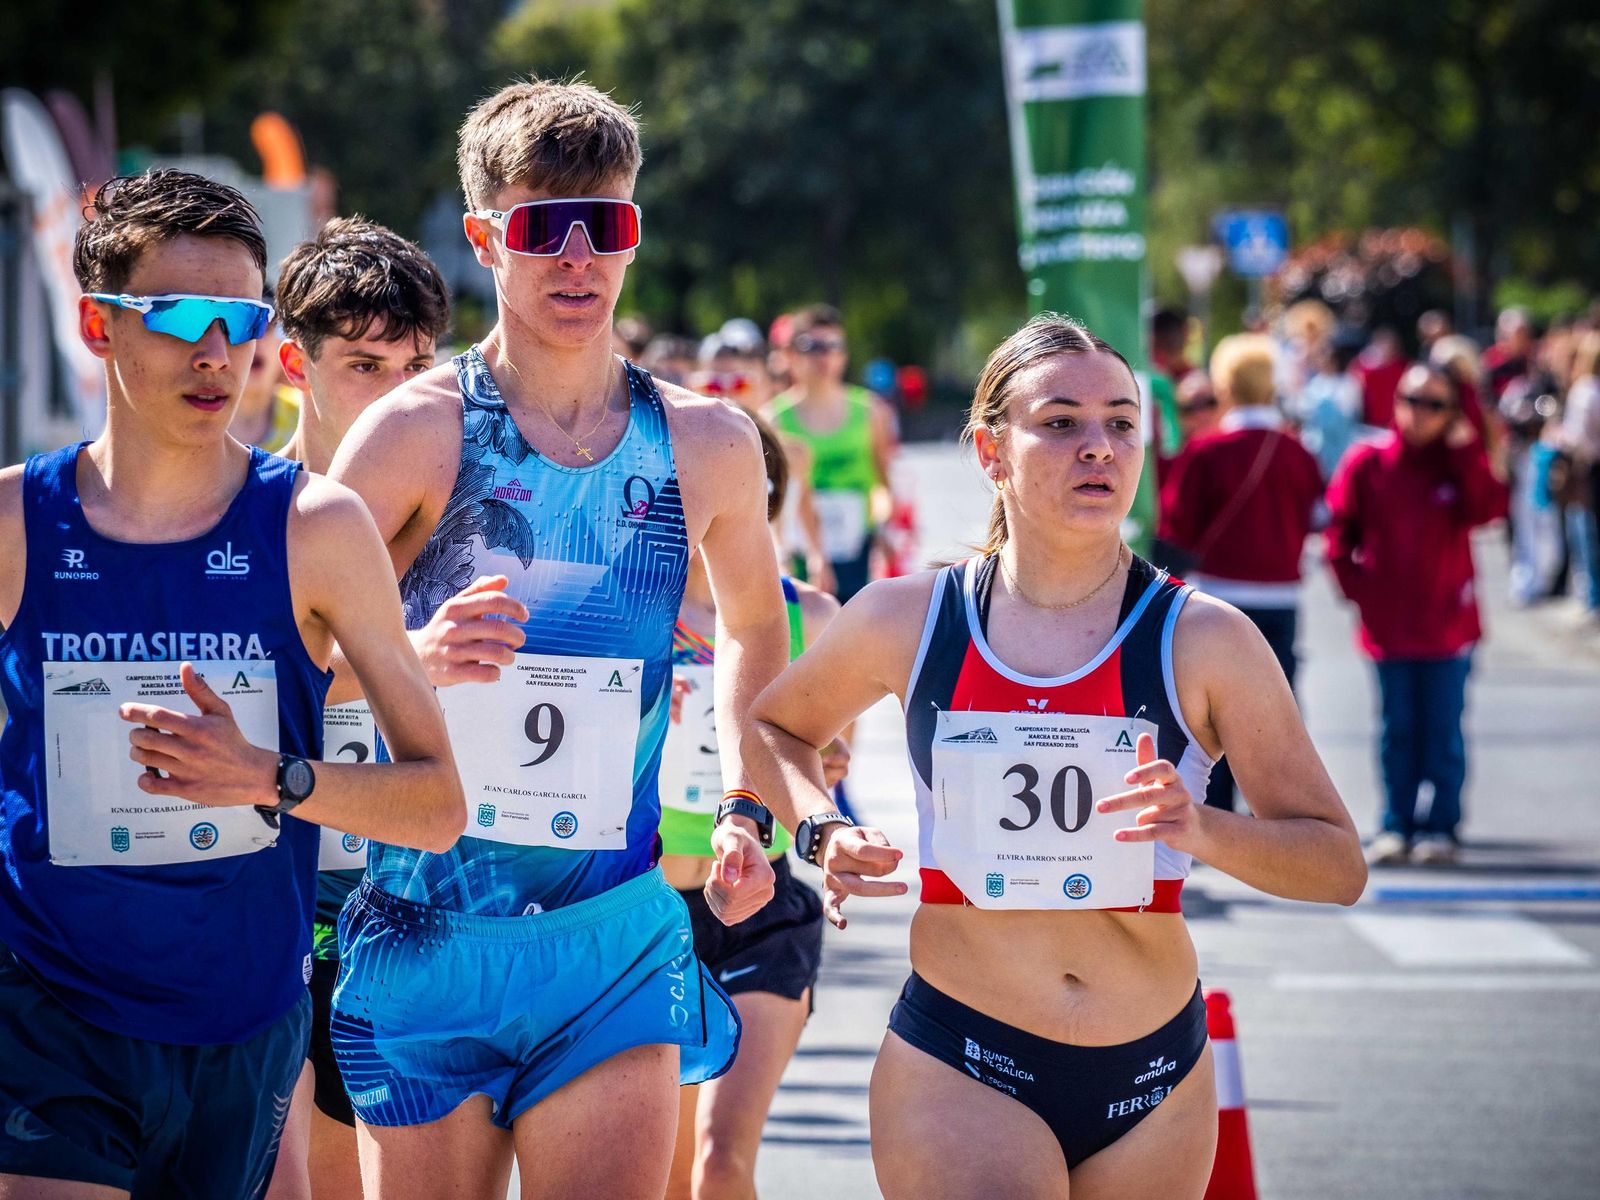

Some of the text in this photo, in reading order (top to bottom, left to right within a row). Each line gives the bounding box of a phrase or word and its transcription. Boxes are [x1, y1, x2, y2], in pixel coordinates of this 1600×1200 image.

[494, 486, 532, 501] HORIZON
[42, 632, 265, 661] TROTASIERRA
[517, 665, 552, 673] CAMPEONATO
[520, 703, 565, 767] 9
[502, 787, 532, 796] CARLOS
[532, 790, 560, 799] GARCIA
[561, 792, 587, 800] GARCIA
[999, 763, 1093, 833] 30
[143, 805, 190, 813] CARABALLO
[997, 853, 1025, 861] ELVIRA
[1058, 854, 1093, 862] SERRANO
[982, 1048, 1015, 1067] XUNTA
[995, 1063, 1035, 1082] GALICIA
[1134, 1060, 1177, 1084] amura
